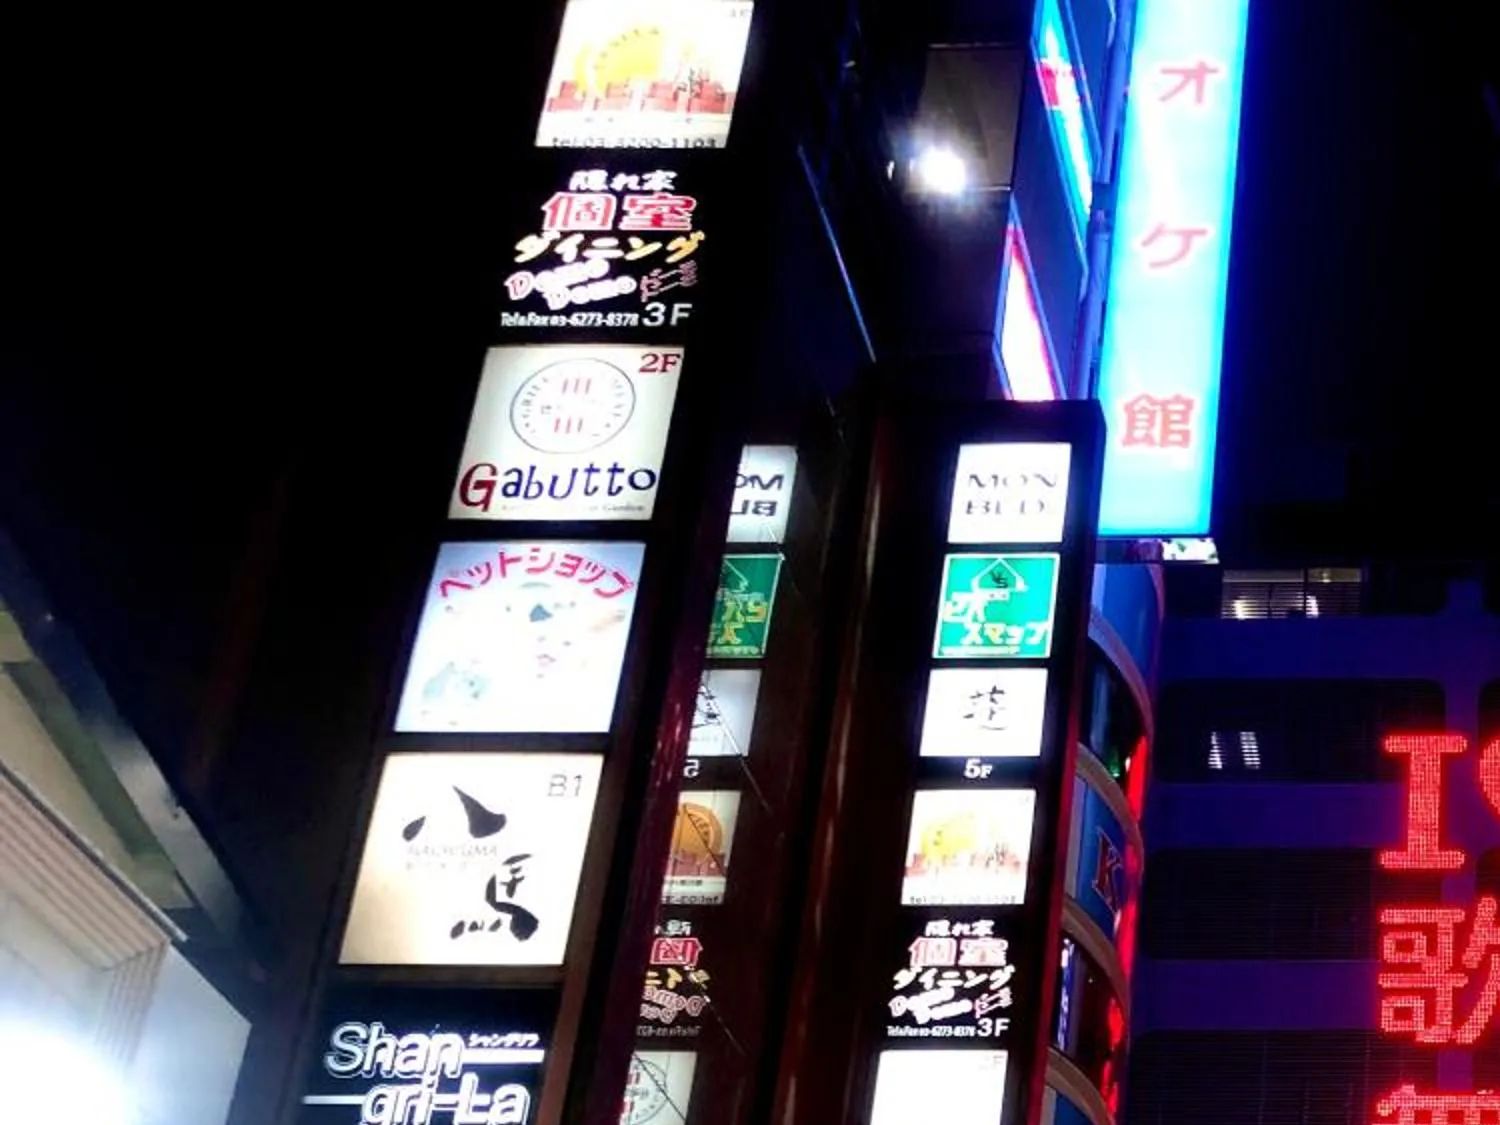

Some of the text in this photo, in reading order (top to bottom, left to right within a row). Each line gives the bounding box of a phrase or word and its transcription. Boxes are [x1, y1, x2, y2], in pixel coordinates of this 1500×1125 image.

[541, 191, 697, 231] 個室
[514, 230, 706, 263] ダイニング
[643, 302, 693, 327] 3F
[639, 353, 681, 374] 2F
[459, 462, 657, 512] Gabutto
[964, 758, 993, 779] 5F
[547, 773, 583, 798] B1
[1379, 734, 1469, 870] I
[324, 1021, 466, 1079] Shan
